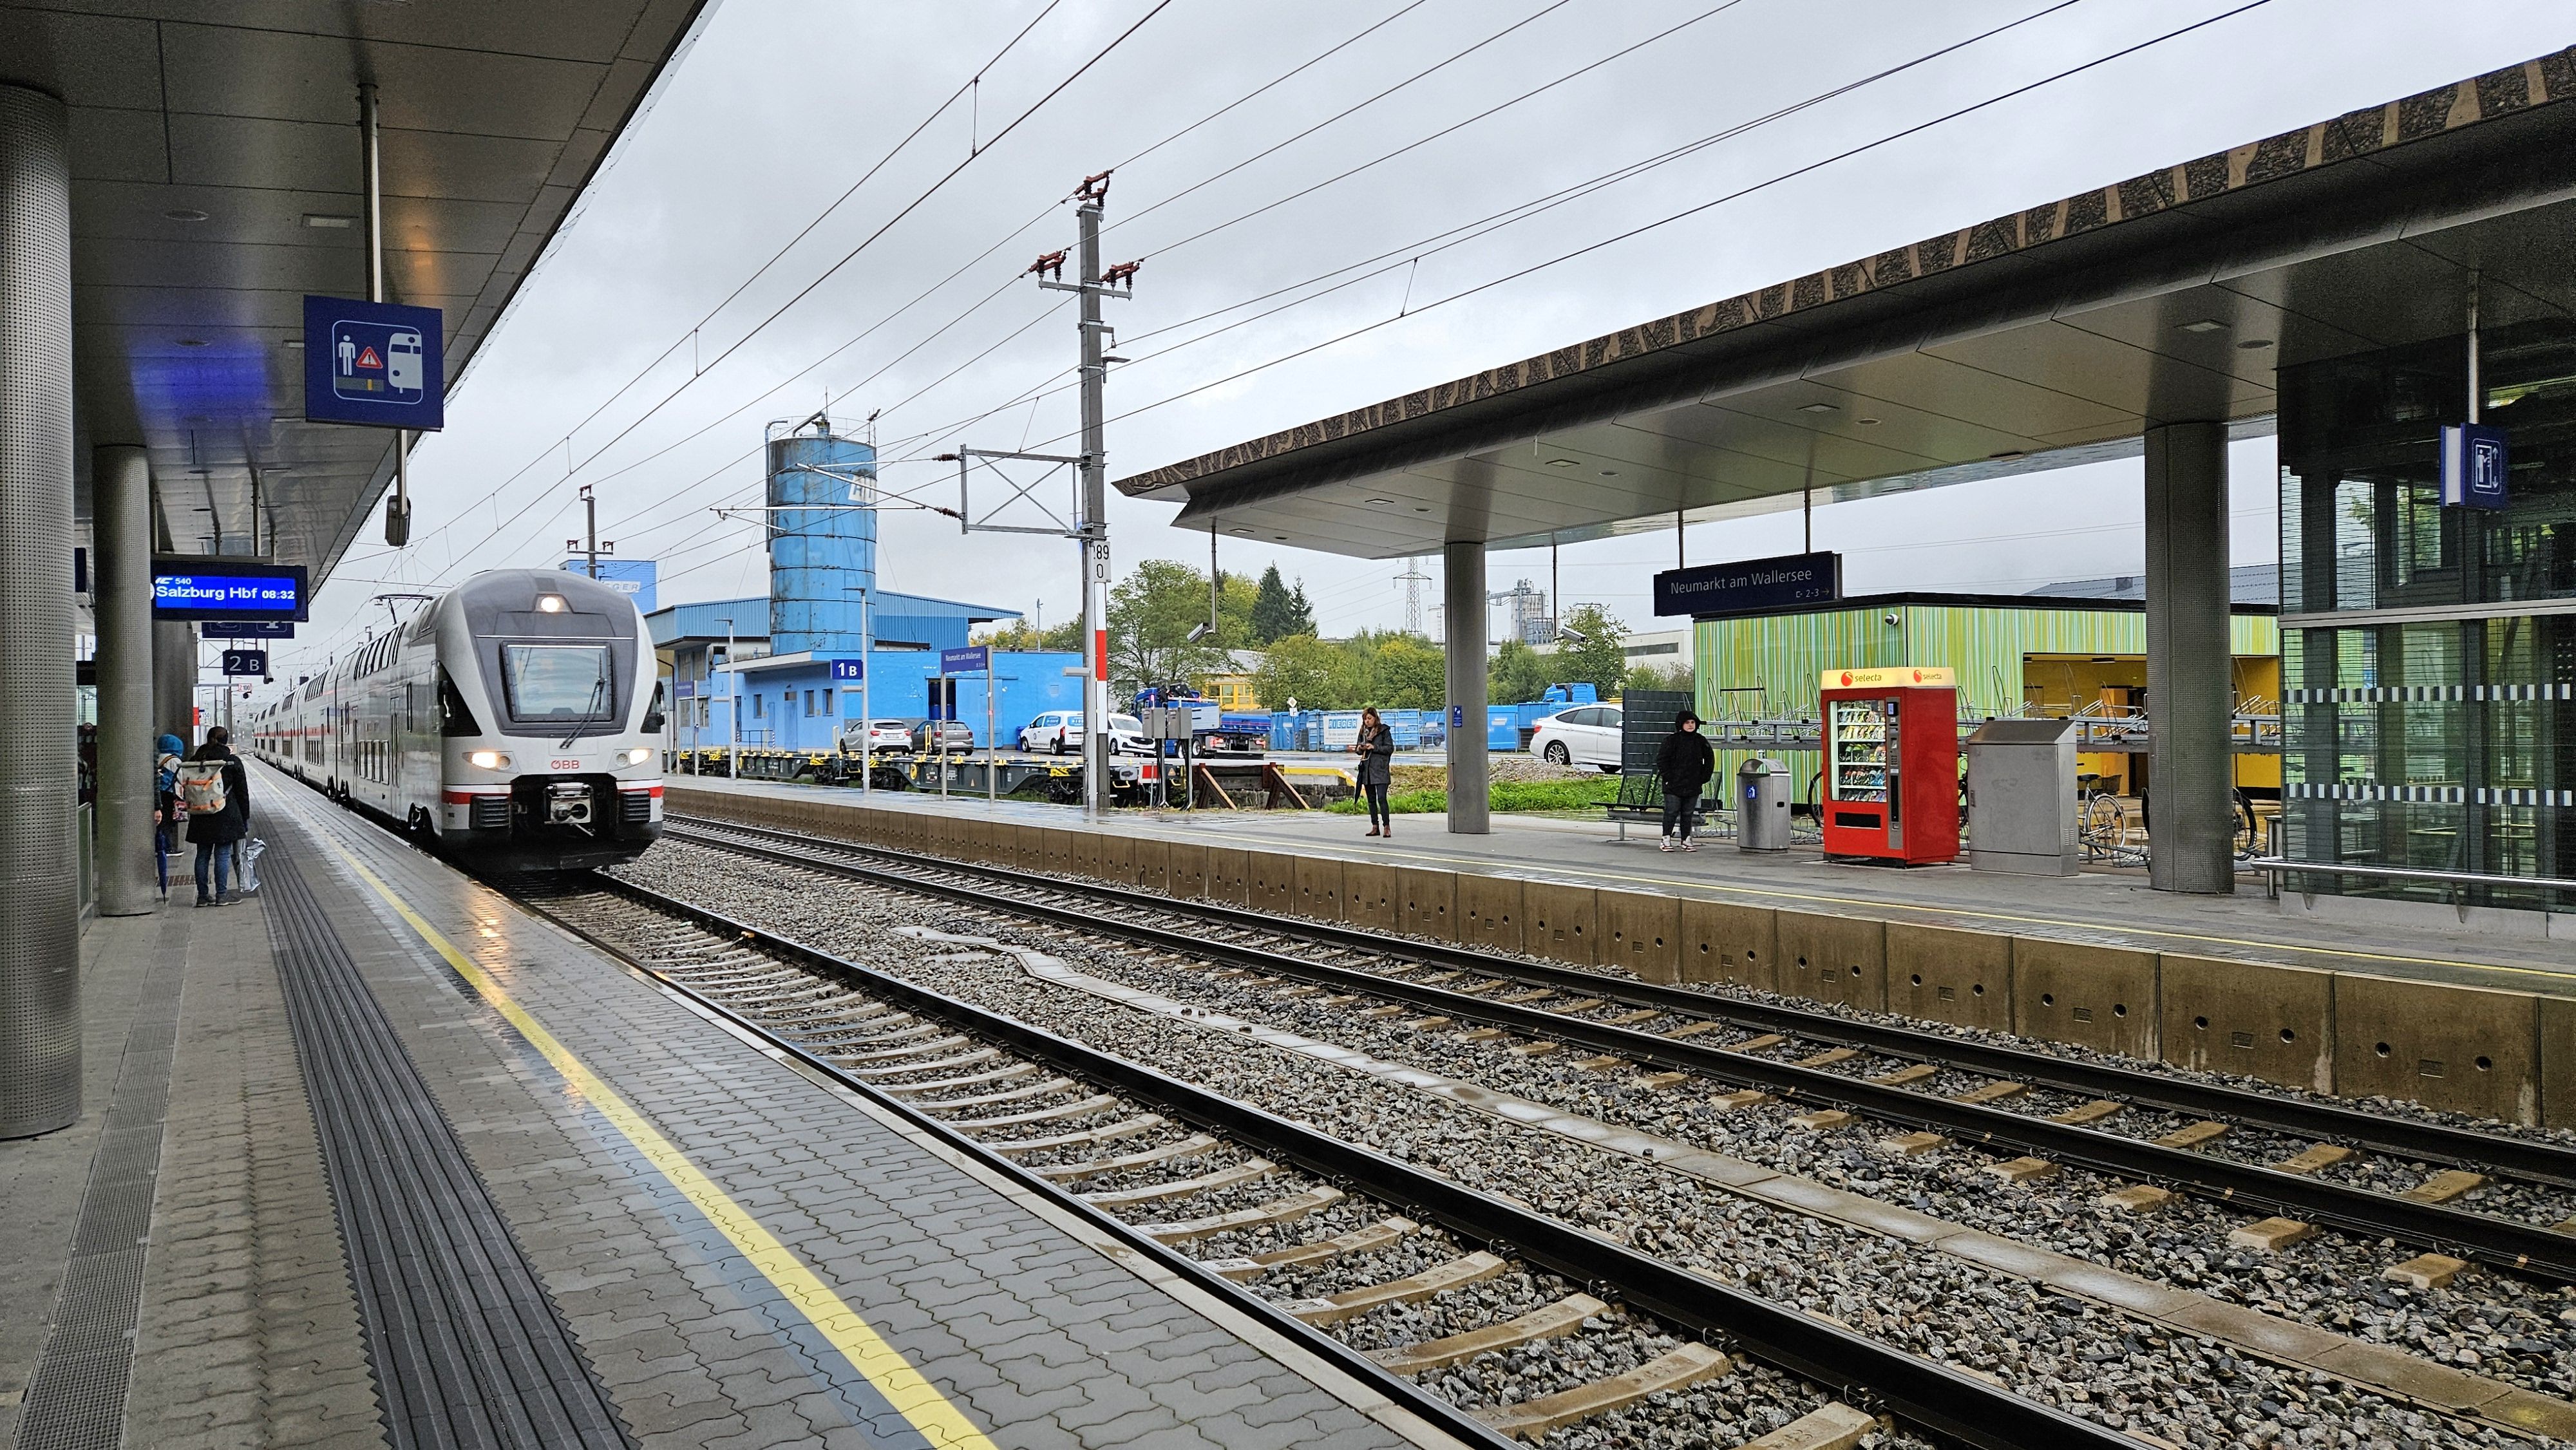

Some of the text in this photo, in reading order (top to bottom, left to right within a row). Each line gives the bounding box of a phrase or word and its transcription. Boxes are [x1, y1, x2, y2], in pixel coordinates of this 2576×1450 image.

[1671, 570, 1812, 594] Neumarkt am Wallersee
[156, 586, 295, 600] Salzburg Hbf 08:32
[1806, 588, 1819, 598] 2-3
[229, 655, 260, 672] 2 B
[838, 663, 857, 676] 1 B
[1854, 674, 1882, 683] selecta
[551, 760, 580, 769] ÖBB
